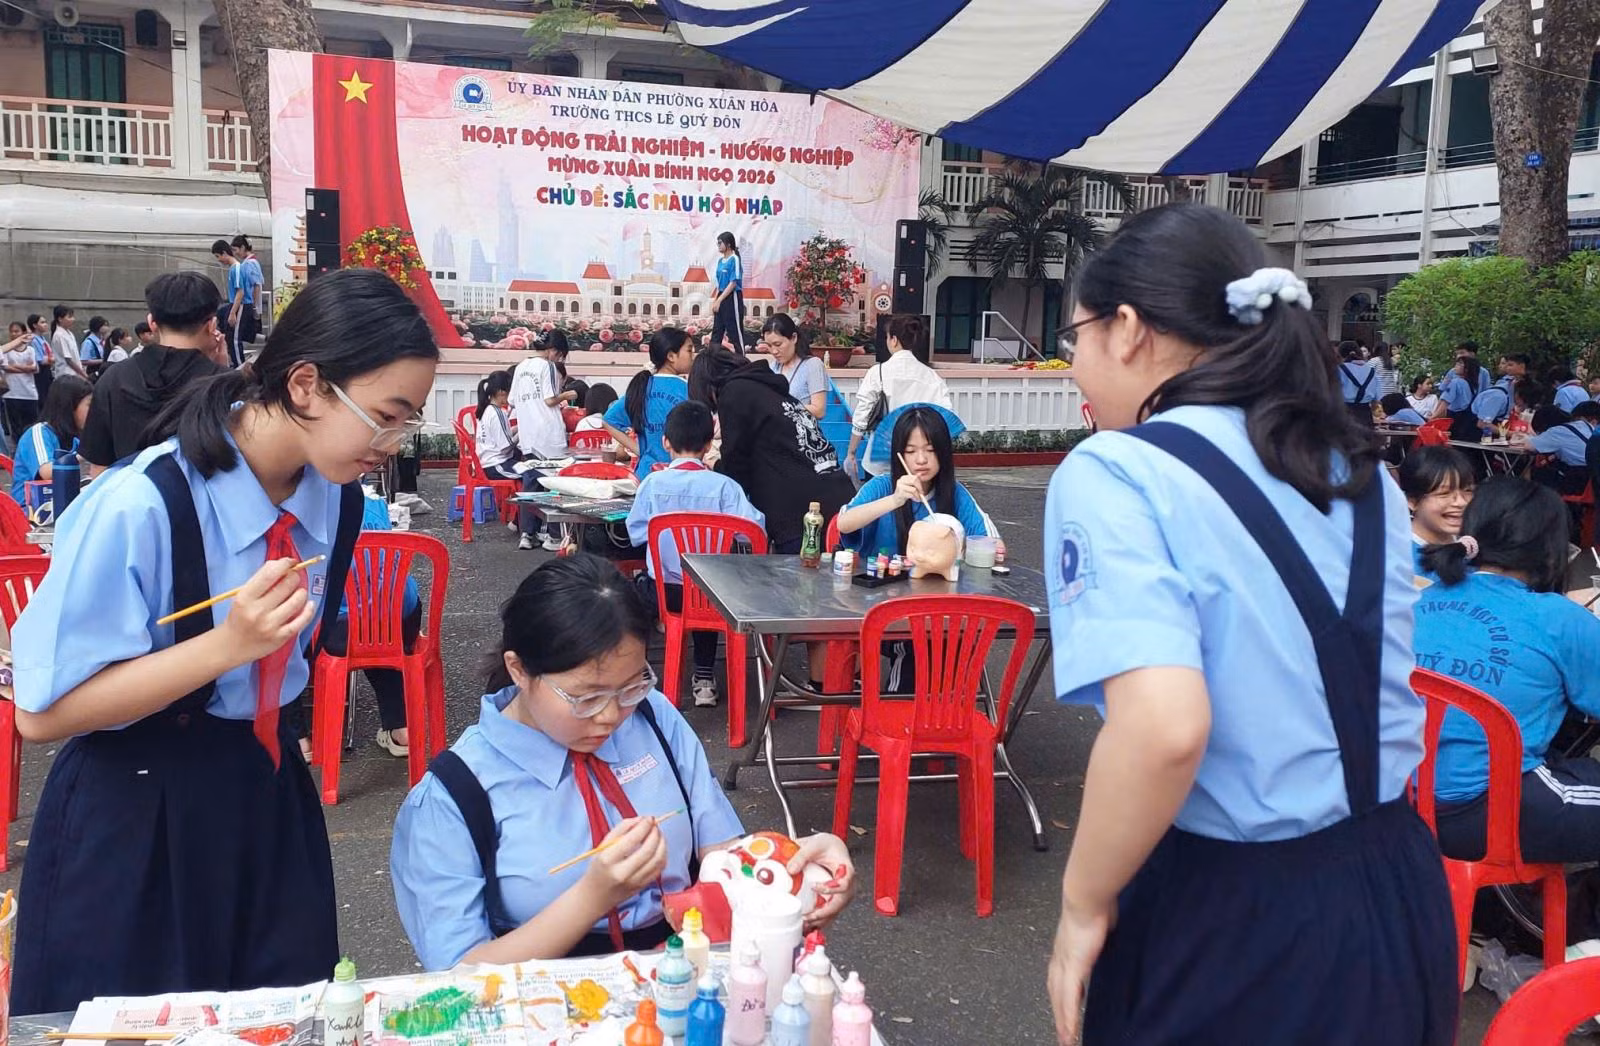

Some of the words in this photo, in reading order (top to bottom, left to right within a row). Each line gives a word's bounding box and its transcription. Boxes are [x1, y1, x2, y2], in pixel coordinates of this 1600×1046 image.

[507, 77, 528, 94] ỦY
[532, 82, 562, 97] BAN
[567, 85, 608, 101] NHÂN
[612, 88, 642, 104] DÂN
[647, 92, 704, 109] PHƯỜNG
[708, 96, 745, 111] XUÂN
[750, 100, 779, 113] HÒA
[550, 104, 610, 120] TRƯỜNG
[614, 110, 653, 123] THCS
[657, 111, 674, 125] LÊ
[679, 111, 708, 128] QUÝ
[713, 114, 741, 129] ĐÔN
[461, 125, 518, 148] HOẠT
[521, 126, 580, 151] ĐỘNG
[584, 129, 627, 153] TRẢI
[631, 136, 705, 161] NGHIỆM
[720, 141, 786, 163] HƯỚNG
[790, 146, 854, 170] NGHIỆP
[547, 154, 600, 174] MỪNG
[603, 159, 650, 178] XUÂN
[654, 161, 694, 181] BÍNH
[697, 166, 734, 186] NGỌ
[737, 169, 776, 185] 2026
[536, 182, 575, 206] CHỦ
[580, 183, 609, 208] ĐỀ:
[613, 184, 649, 210] SẮC
[653, 190, 694, 213] MÀU
[698, 193, 730, 218] HỘI
[735, 195, 783, 220] NHẬP
[1448, 658, 1506, 686] ĐÔN
